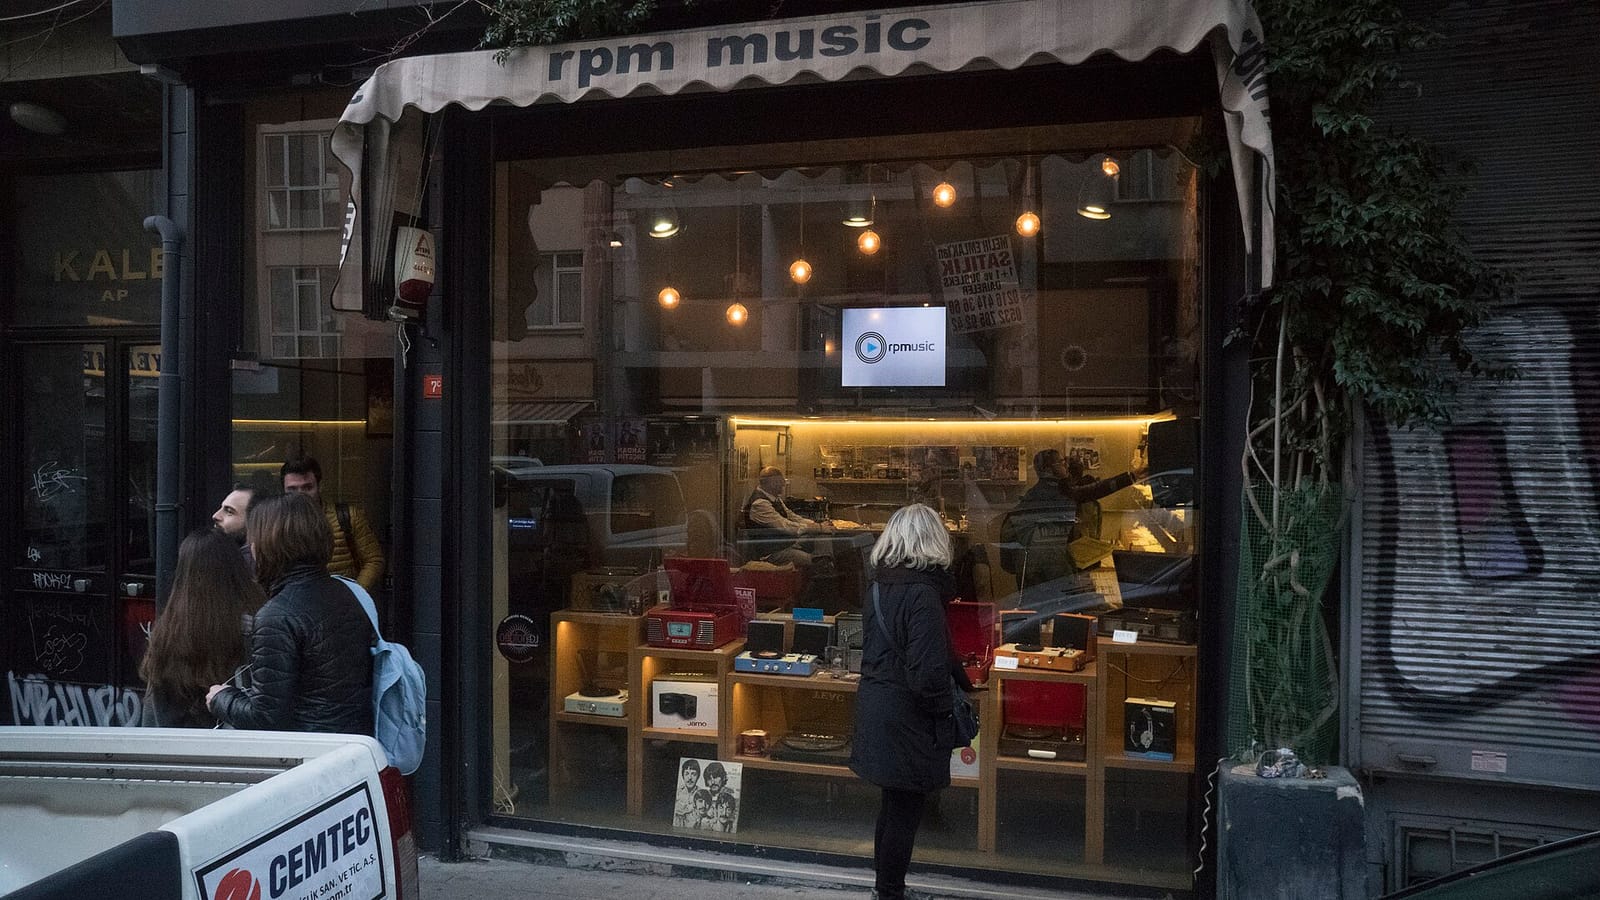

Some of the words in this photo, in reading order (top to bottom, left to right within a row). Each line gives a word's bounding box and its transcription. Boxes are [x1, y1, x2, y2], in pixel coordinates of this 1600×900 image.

[548, 41, 675, 89] rpm
[707, 14, 931, 68] music
[54, 247, 163, 281] KALE
[99, 289, 129, 302] AP
[888, 340, 935, 355] rpmusic
[269, 807, 370, 900] CEMTEC
[319, 879, 338, 896] SAN.
[338, 870, 349, 883] VE
[349, 862, 362, 876] TİC.
